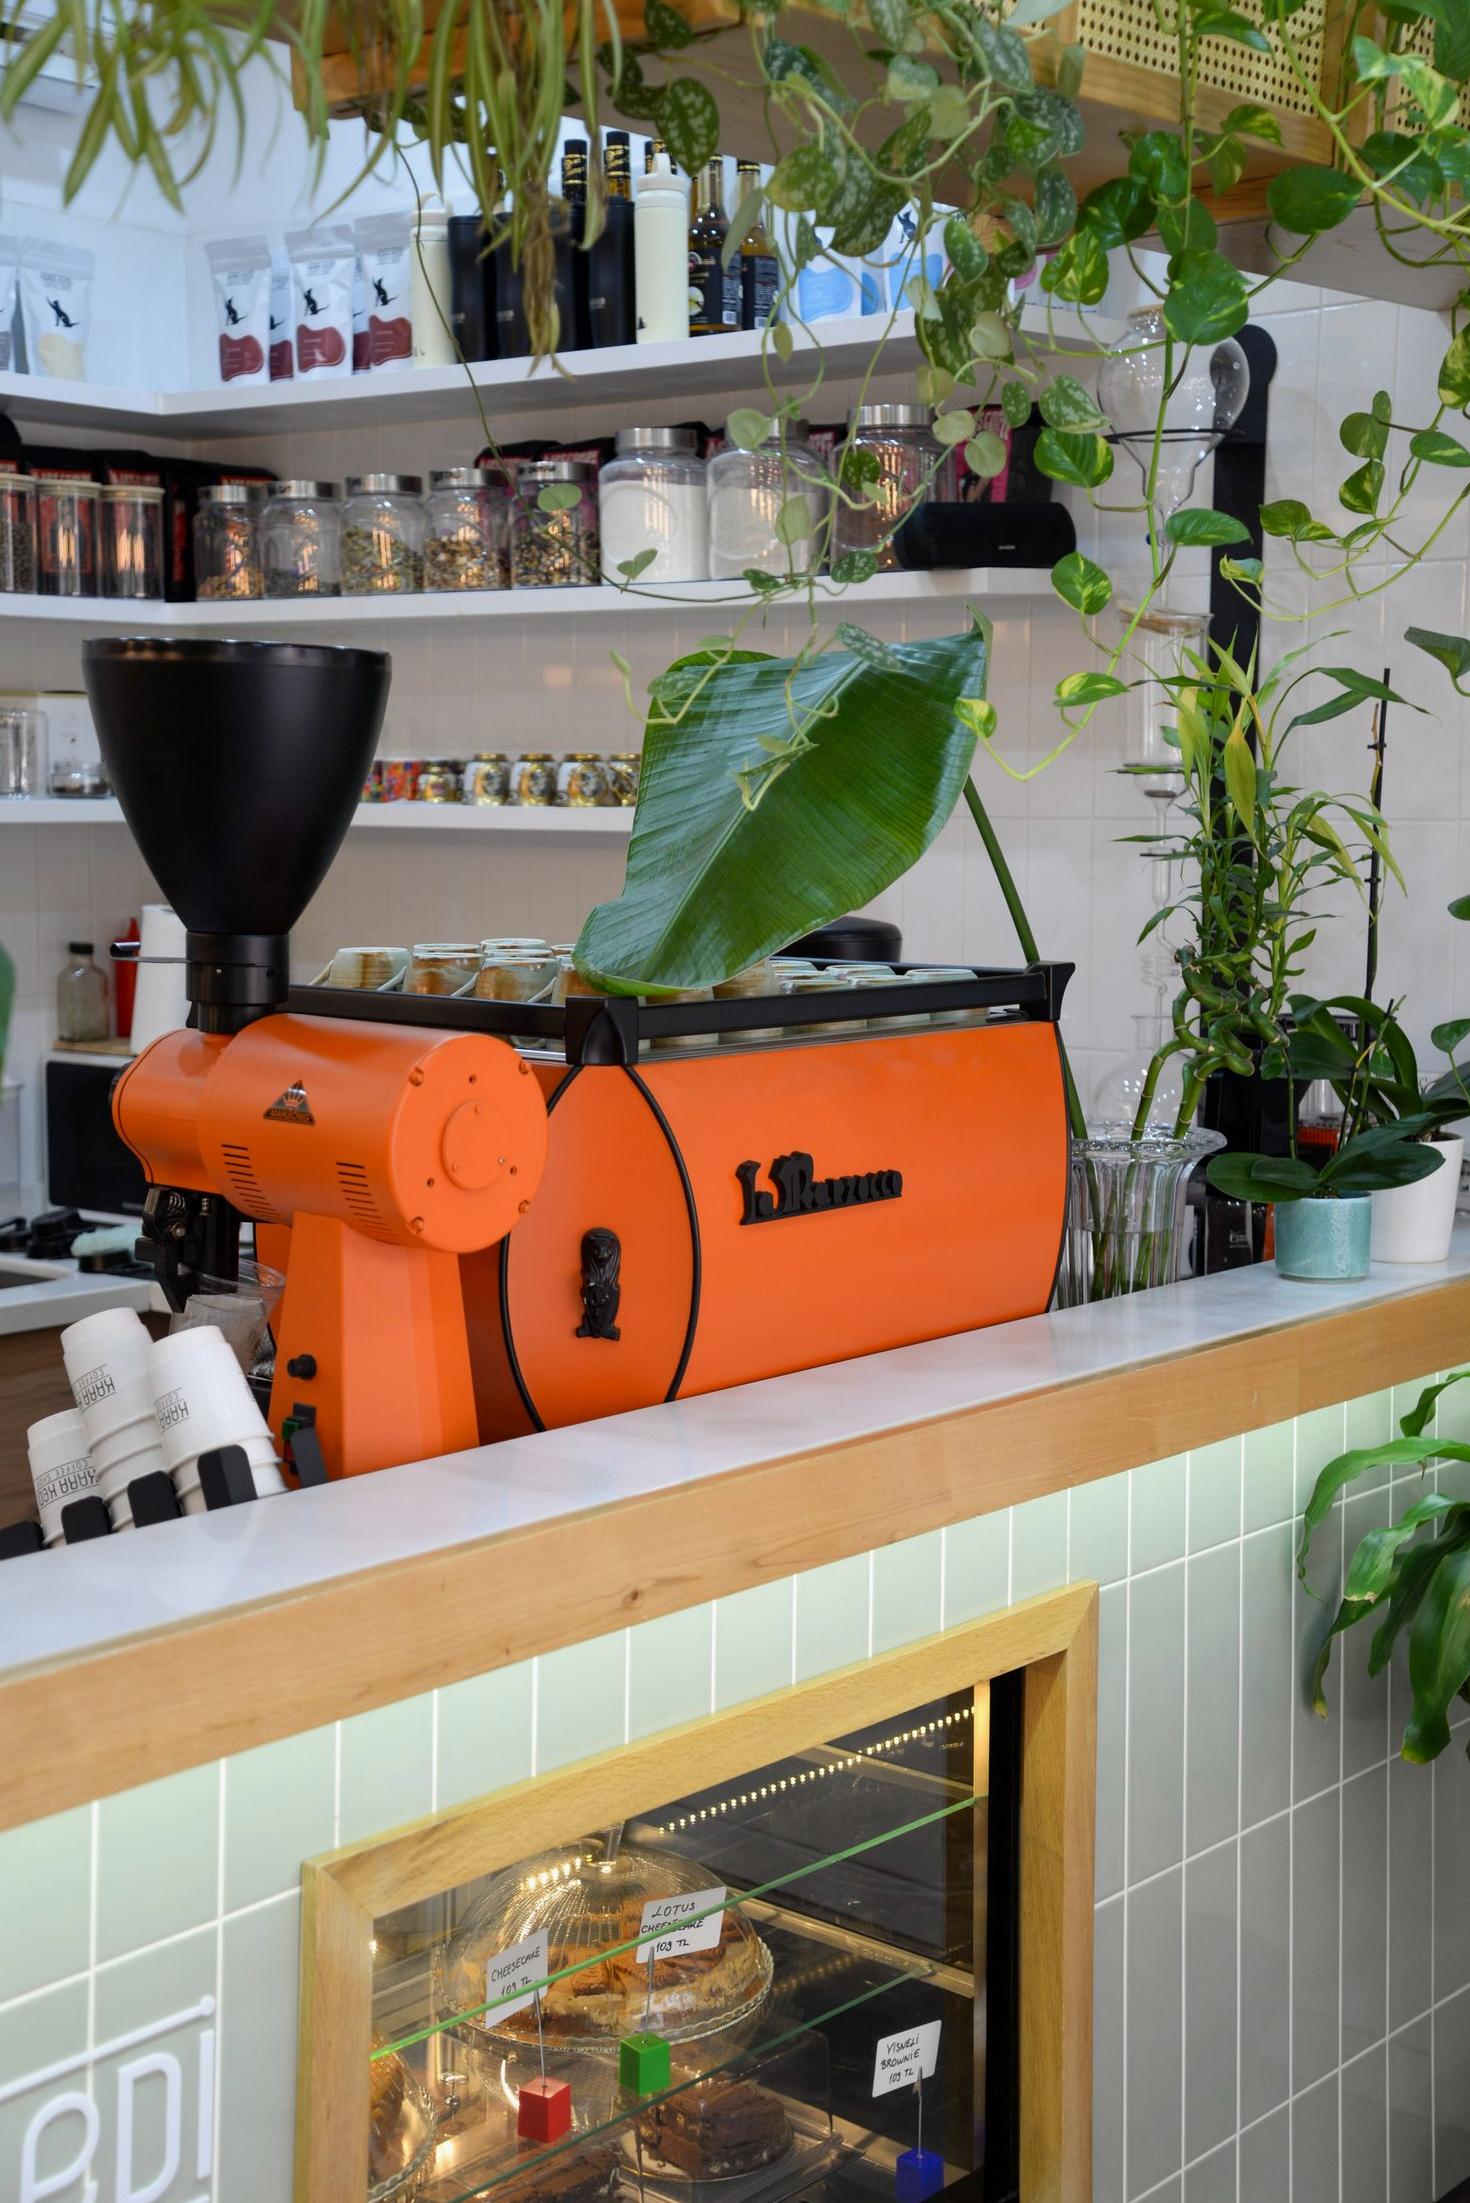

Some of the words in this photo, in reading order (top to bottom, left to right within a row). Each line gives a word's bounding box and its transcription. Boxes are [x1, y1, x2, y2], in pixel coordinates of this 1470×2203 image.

[652, 1902, 696, 1918] LOTUS
[676, 1938, 690, 1947] TL
[491, 1946, 541, 1983] CHEESECAKE
[521, 1976, 533, 1987] TL
[881, 2048, 919, 2069] BROWNIE
[905, 2068, 914, 2077] TL
